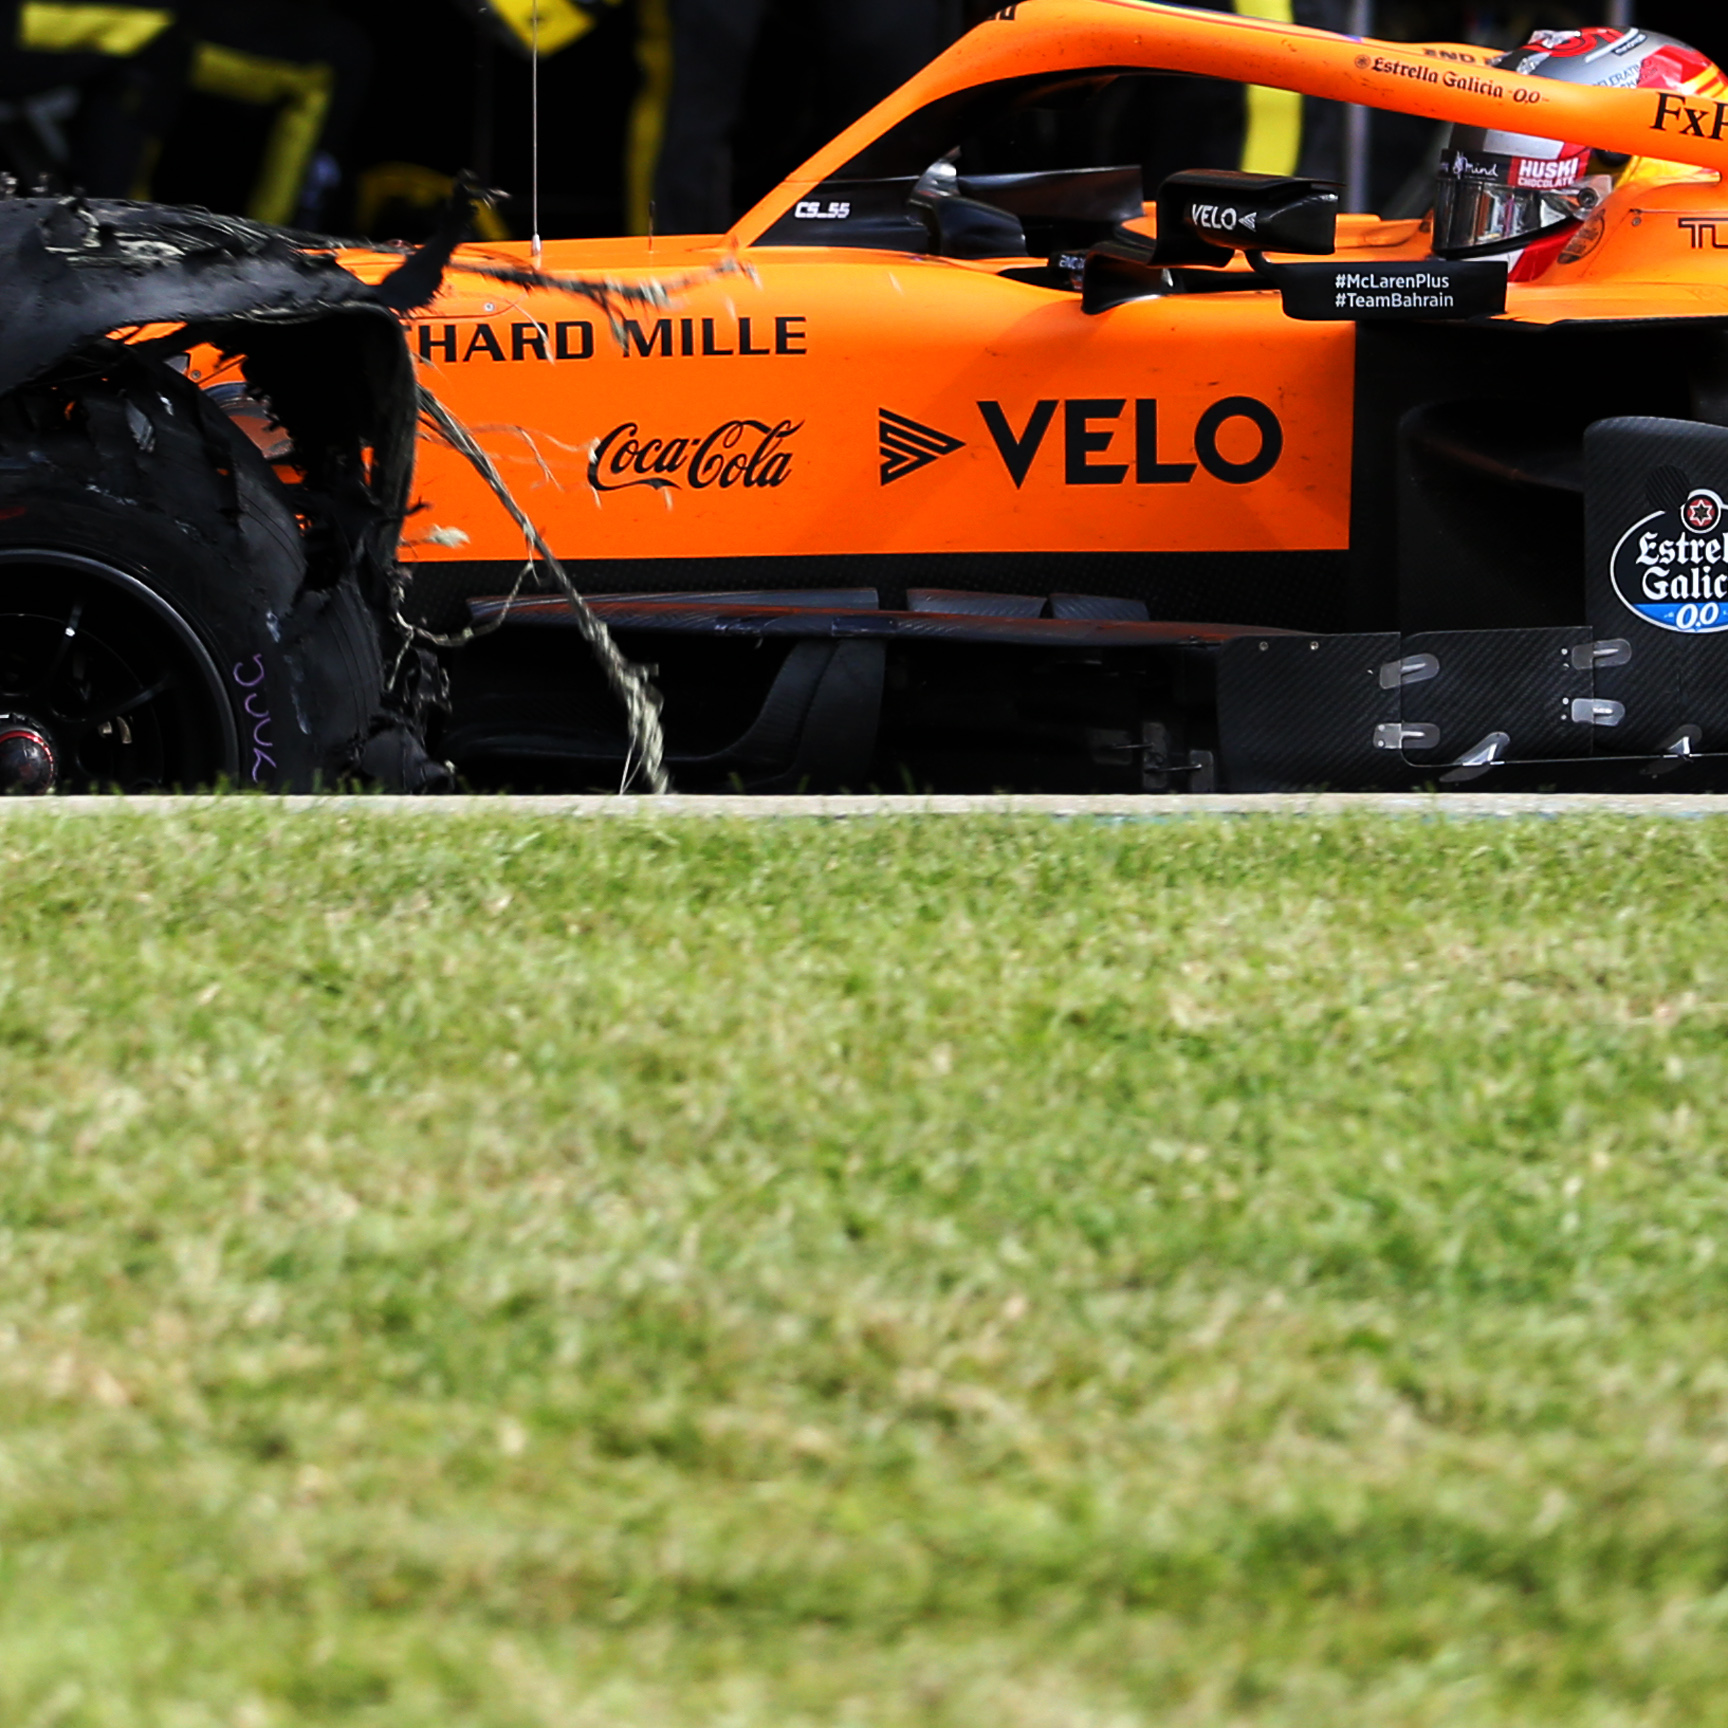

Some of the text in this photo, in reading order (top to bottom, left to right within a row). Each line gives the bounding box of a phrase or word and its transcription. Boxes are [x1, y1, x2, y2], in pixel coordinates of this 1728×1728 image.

[1372, 57, 1438, 84] Estrella
[1442, 71, 1504, 99] Galicia
[1518, 157, 1580, 179] HUSKI
[795, 201, 850, 219] CS_55
[1191, 203, 1237, 231] VELO
[1335, 273, 1450, 290] #McLarenPlus
[1335, 292, 1454, 309] #TeamBahrain
[403, 317, 807, 362] HARD MILLE
[587, 419, 805, 491] Coca-Cola
[977, 395, 1284, 489] VELO
